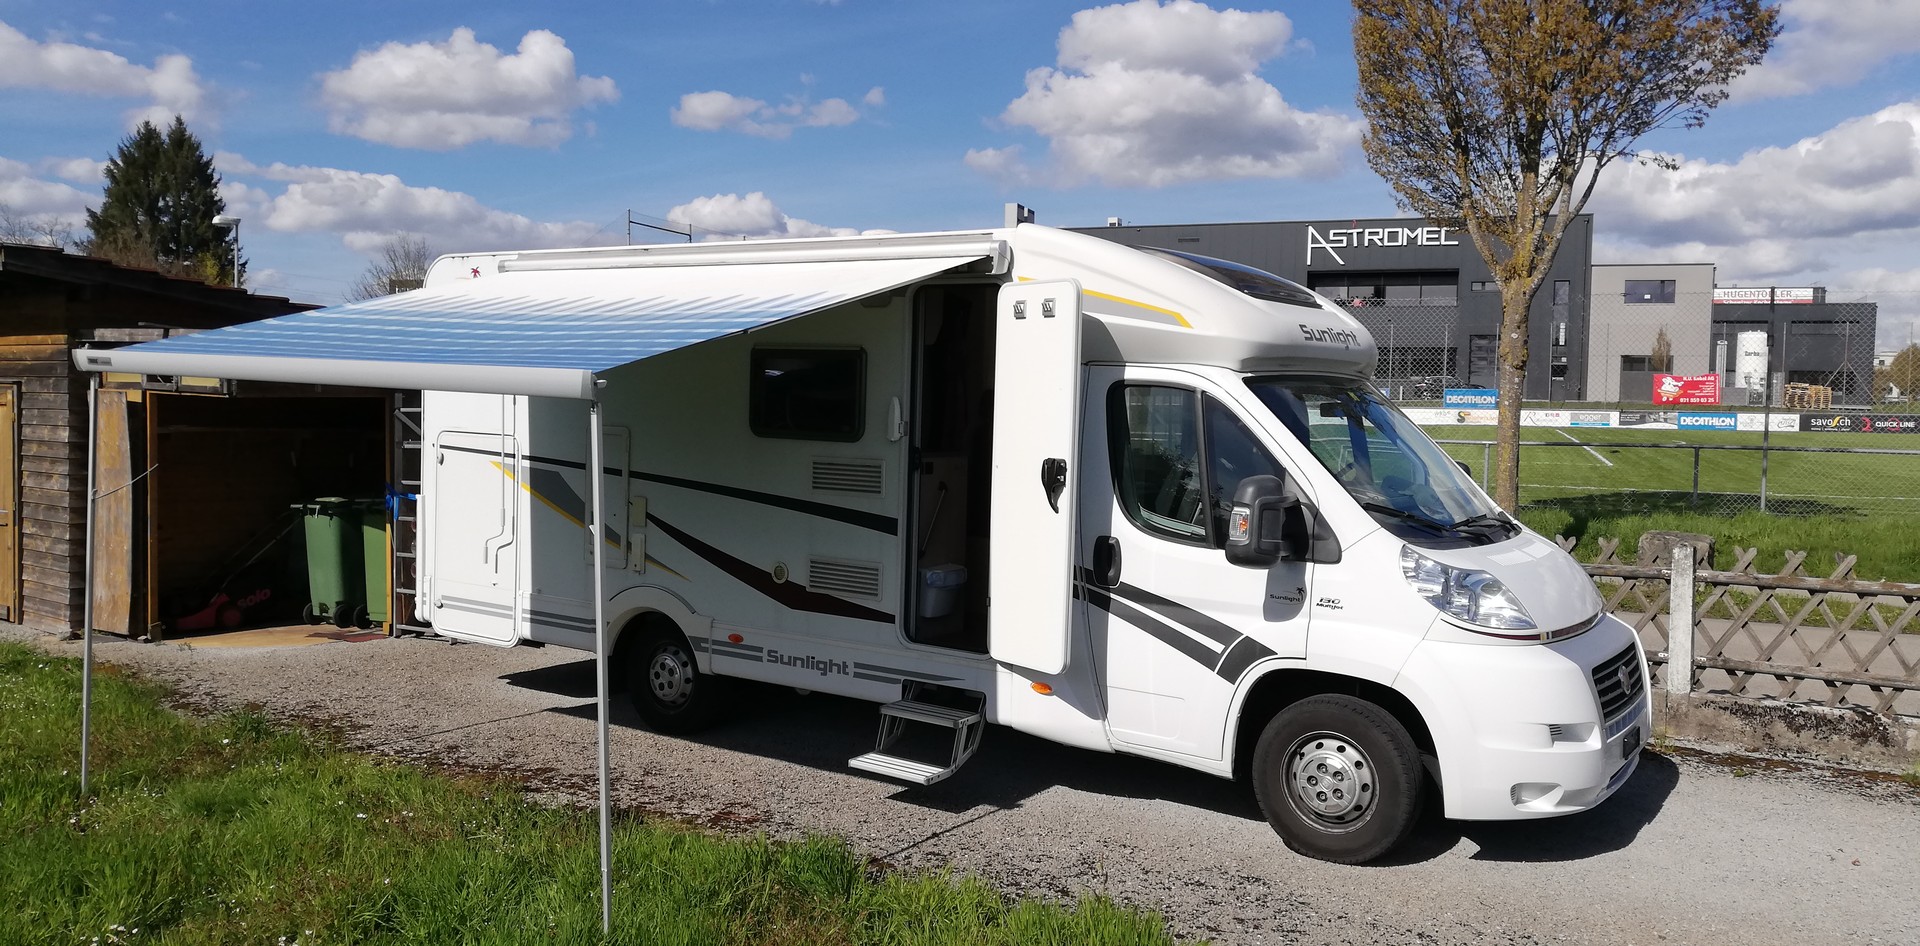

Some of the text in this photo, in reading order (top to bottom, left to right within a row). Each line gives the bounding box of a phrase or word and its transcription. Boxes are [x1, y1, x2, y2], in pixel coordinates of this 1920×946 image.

[1306, 224, 1459, 266] ASTROMEC
[1299, 324, 1361, 351] Sunlight
[1446, 395, 1496, 404] DECATHLON
[1680, 416, 1735, 426] DECATHLON
[237, 588, 271, 609] solo
[1270, 594, 1301, 603] Sunlight
[1319, 597, 1341, 605] 130
[766, 649, 850, 677] Sunlight
